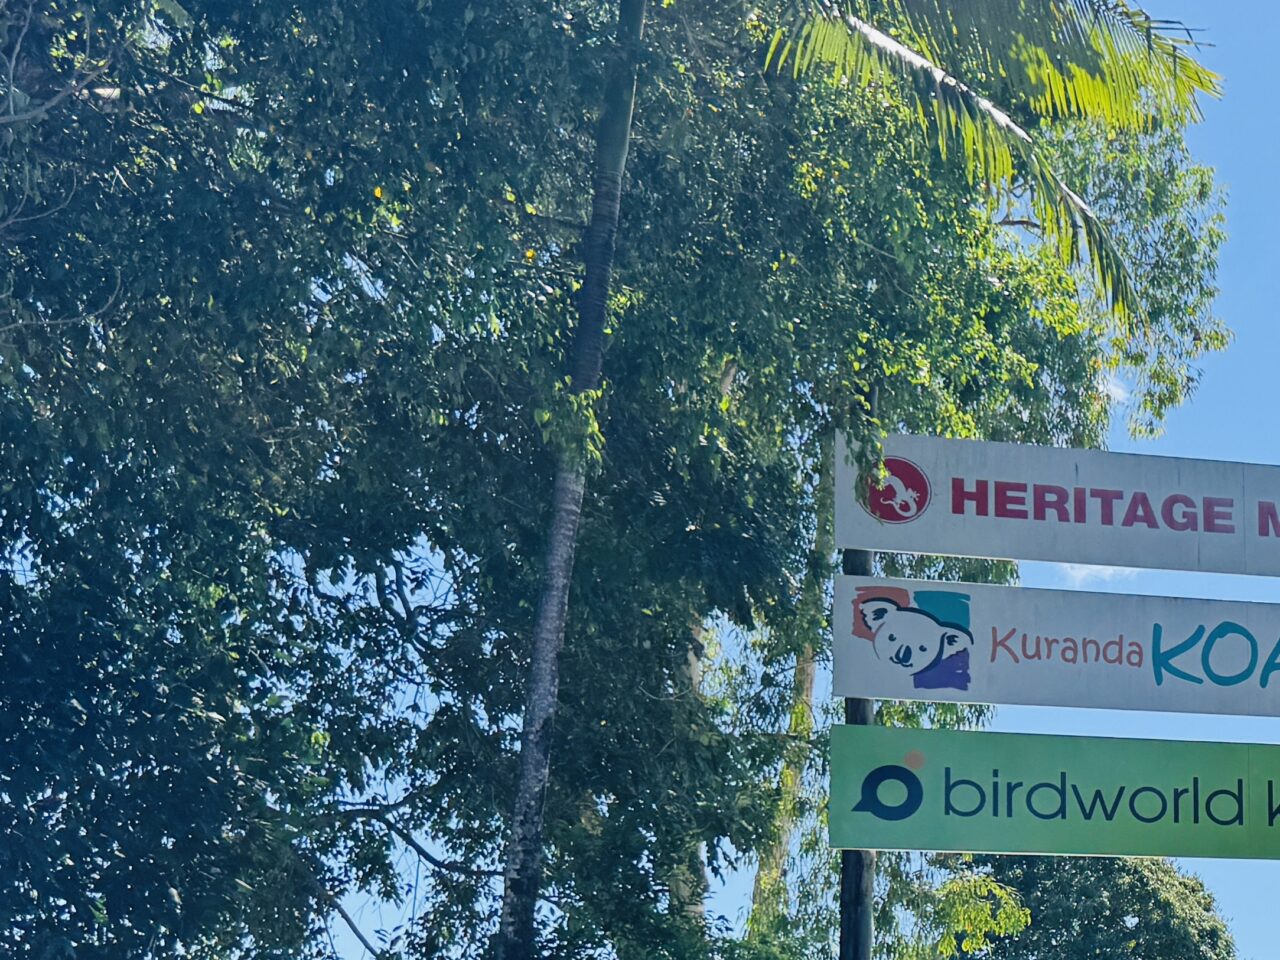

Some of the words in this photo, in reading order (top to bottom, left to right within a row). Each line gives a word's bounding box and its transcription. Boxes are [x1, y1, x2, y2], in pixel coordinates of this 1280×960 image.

[951, 477, 1235, 535] HERITAGE
[990, 626, 1144, 668] Kuranda
[944, 767, 1243, 826] birdworld
